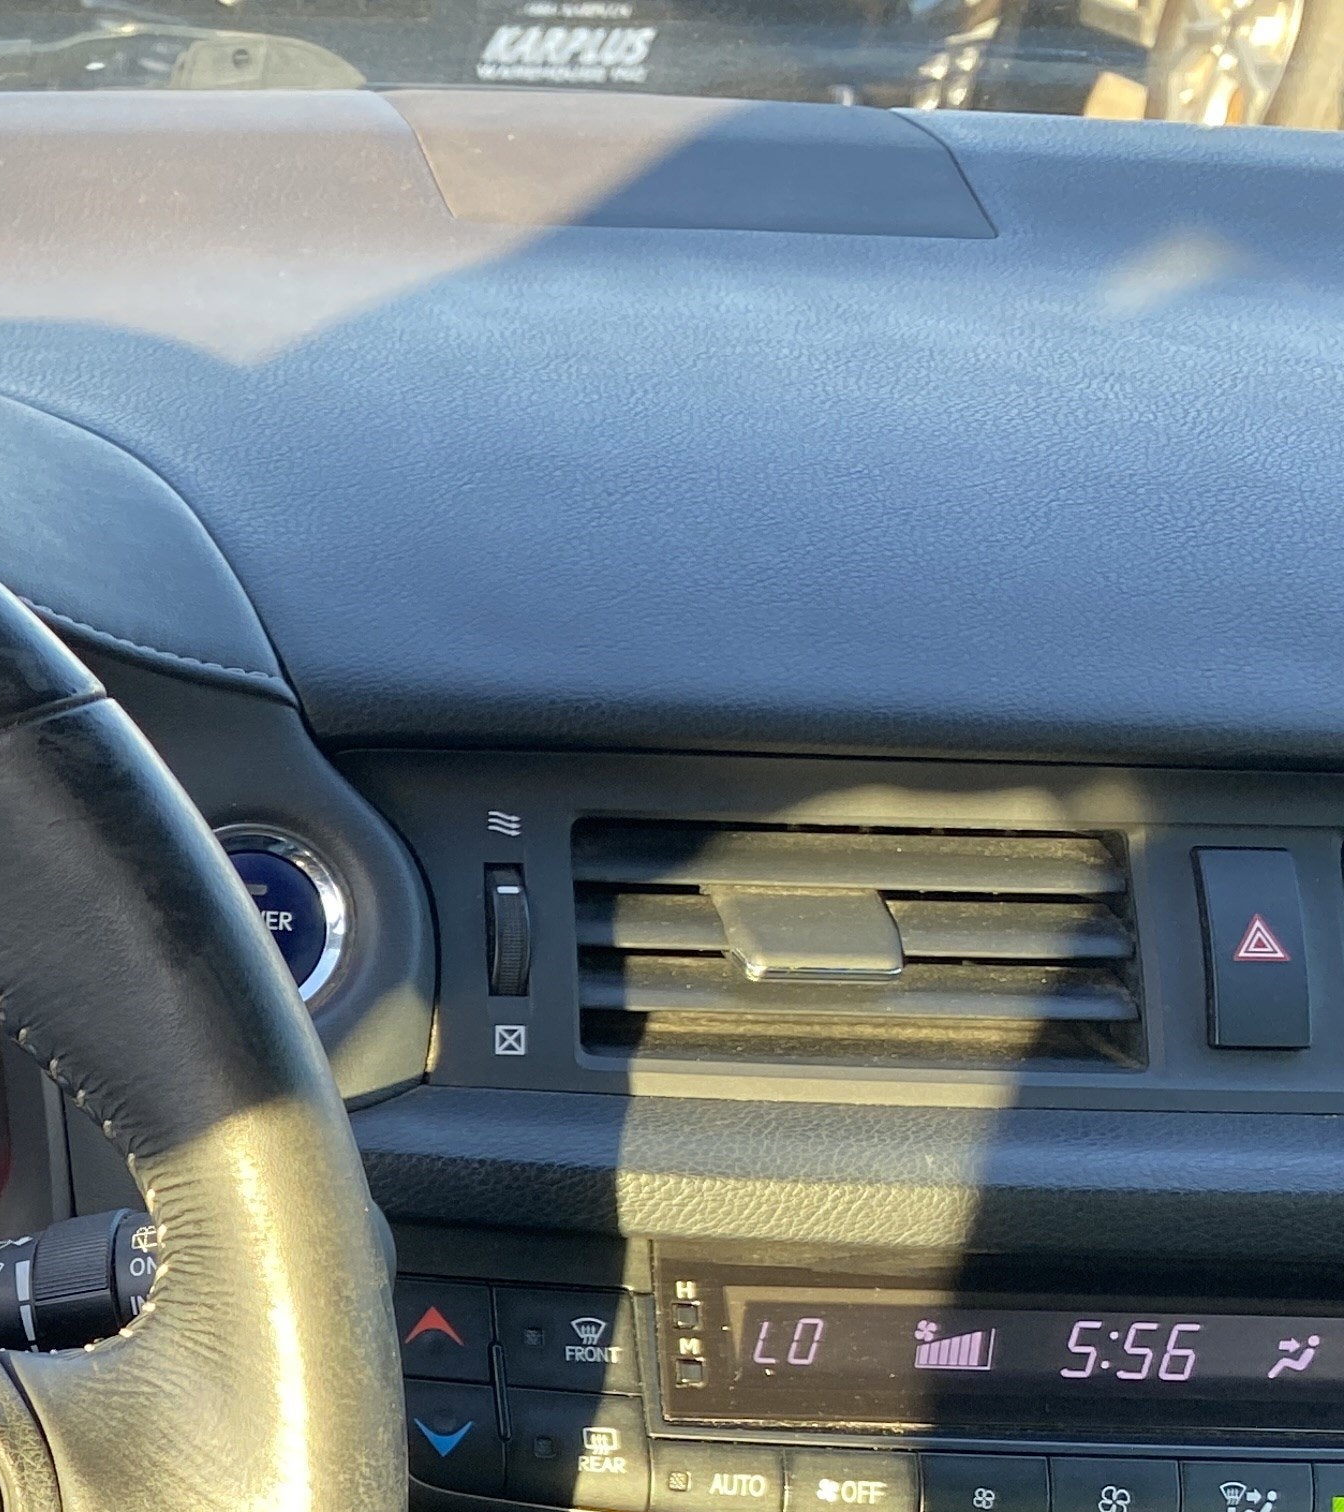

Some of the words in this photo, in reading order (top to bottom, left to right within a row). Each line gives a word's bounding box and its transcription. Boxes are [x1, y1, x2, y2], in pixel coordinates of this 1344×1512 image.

[676, 1280, 696, 1299] H
[565, 1346, 621, 1363] FRONT
[679, 1337, 701, 1355] M
[1060, 1320, 1201, 1381] 5:56
[578, 1457, 627, 1474] REAR
[709, 1474, 765, 1496] AUTO
[840, 1481, 886, 1503] OFF
